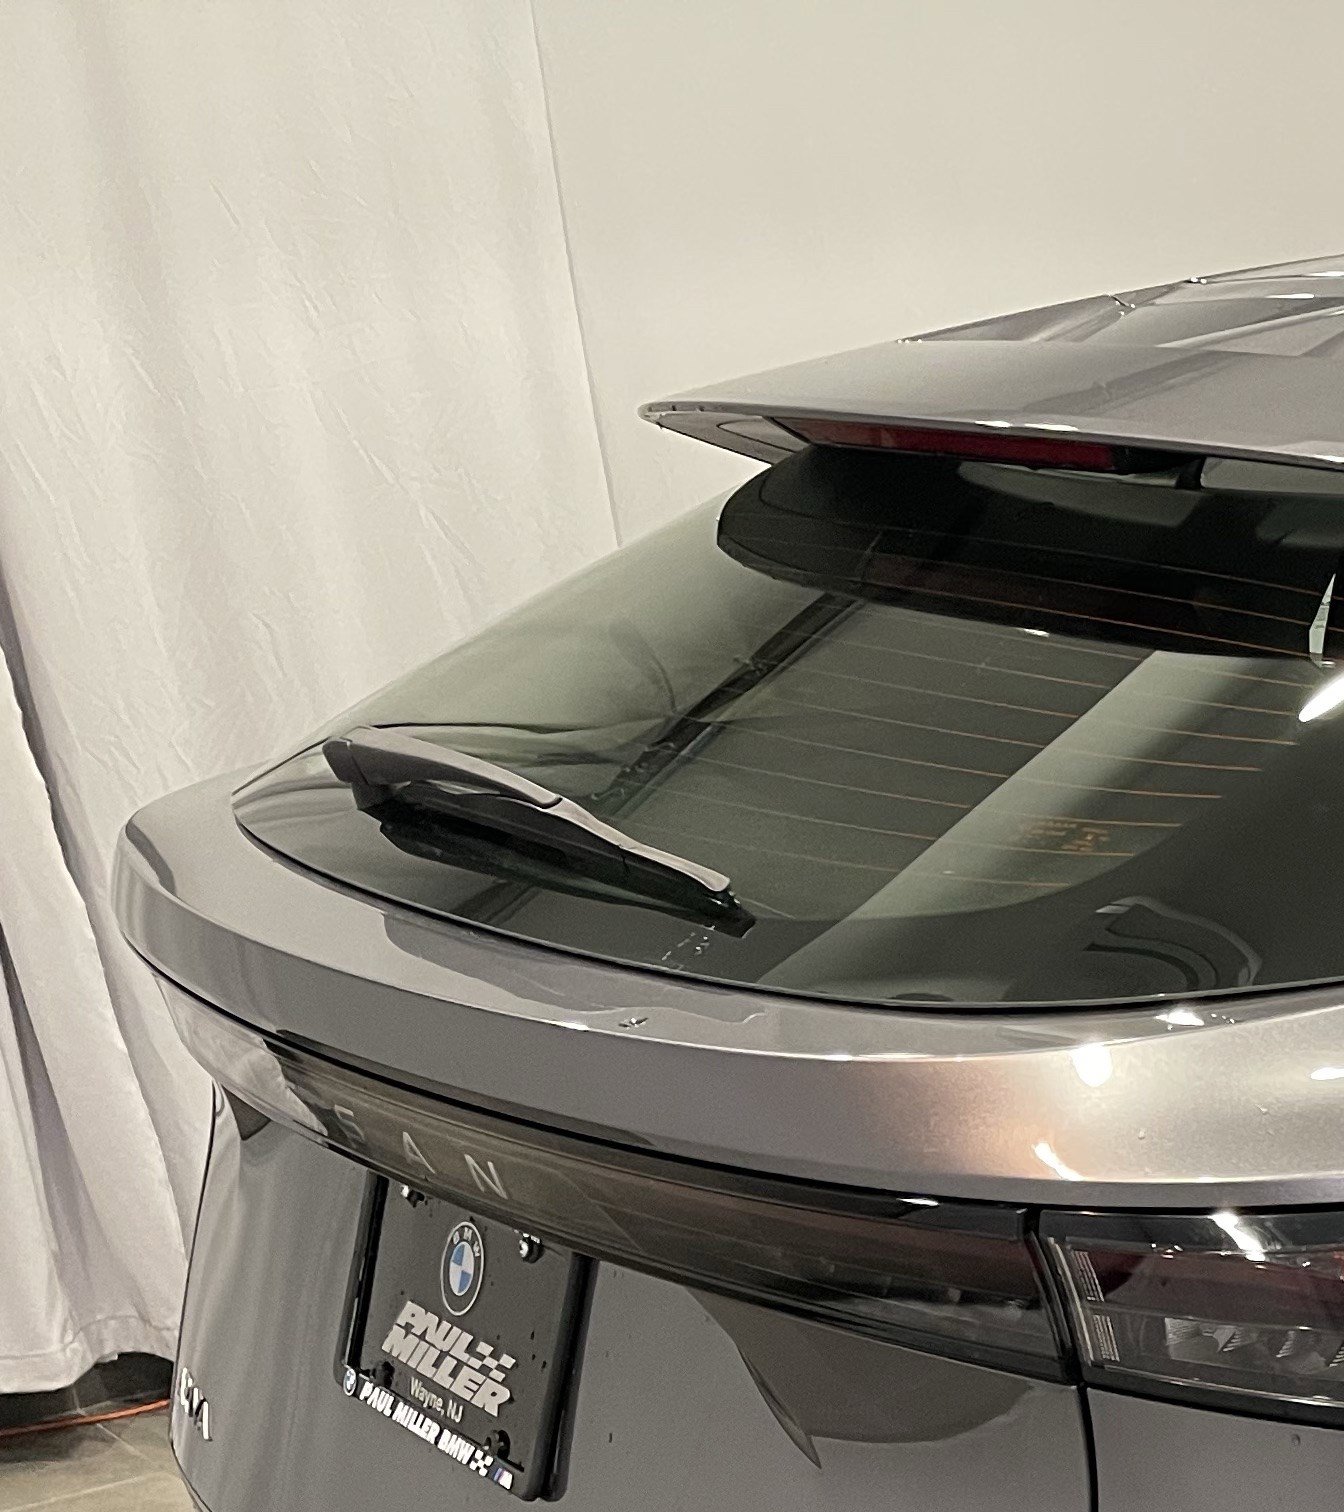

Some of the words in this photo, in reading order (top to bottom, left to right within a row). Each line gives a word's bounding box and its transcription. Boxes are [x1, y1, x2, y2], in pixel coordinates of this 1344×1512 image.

[396, 1300, 474, 1359] PAUL
[381, 1325, 511, 1417] MILLER
[410, 1377, 445, 1417] Wayne,
[446, 1399, 464, 1423] NJ
[358, 1381, 395, 1417] PAUL
[391, 1401, 441, 1445] MILLER
[437, 1428, 476, 1465] BMW
